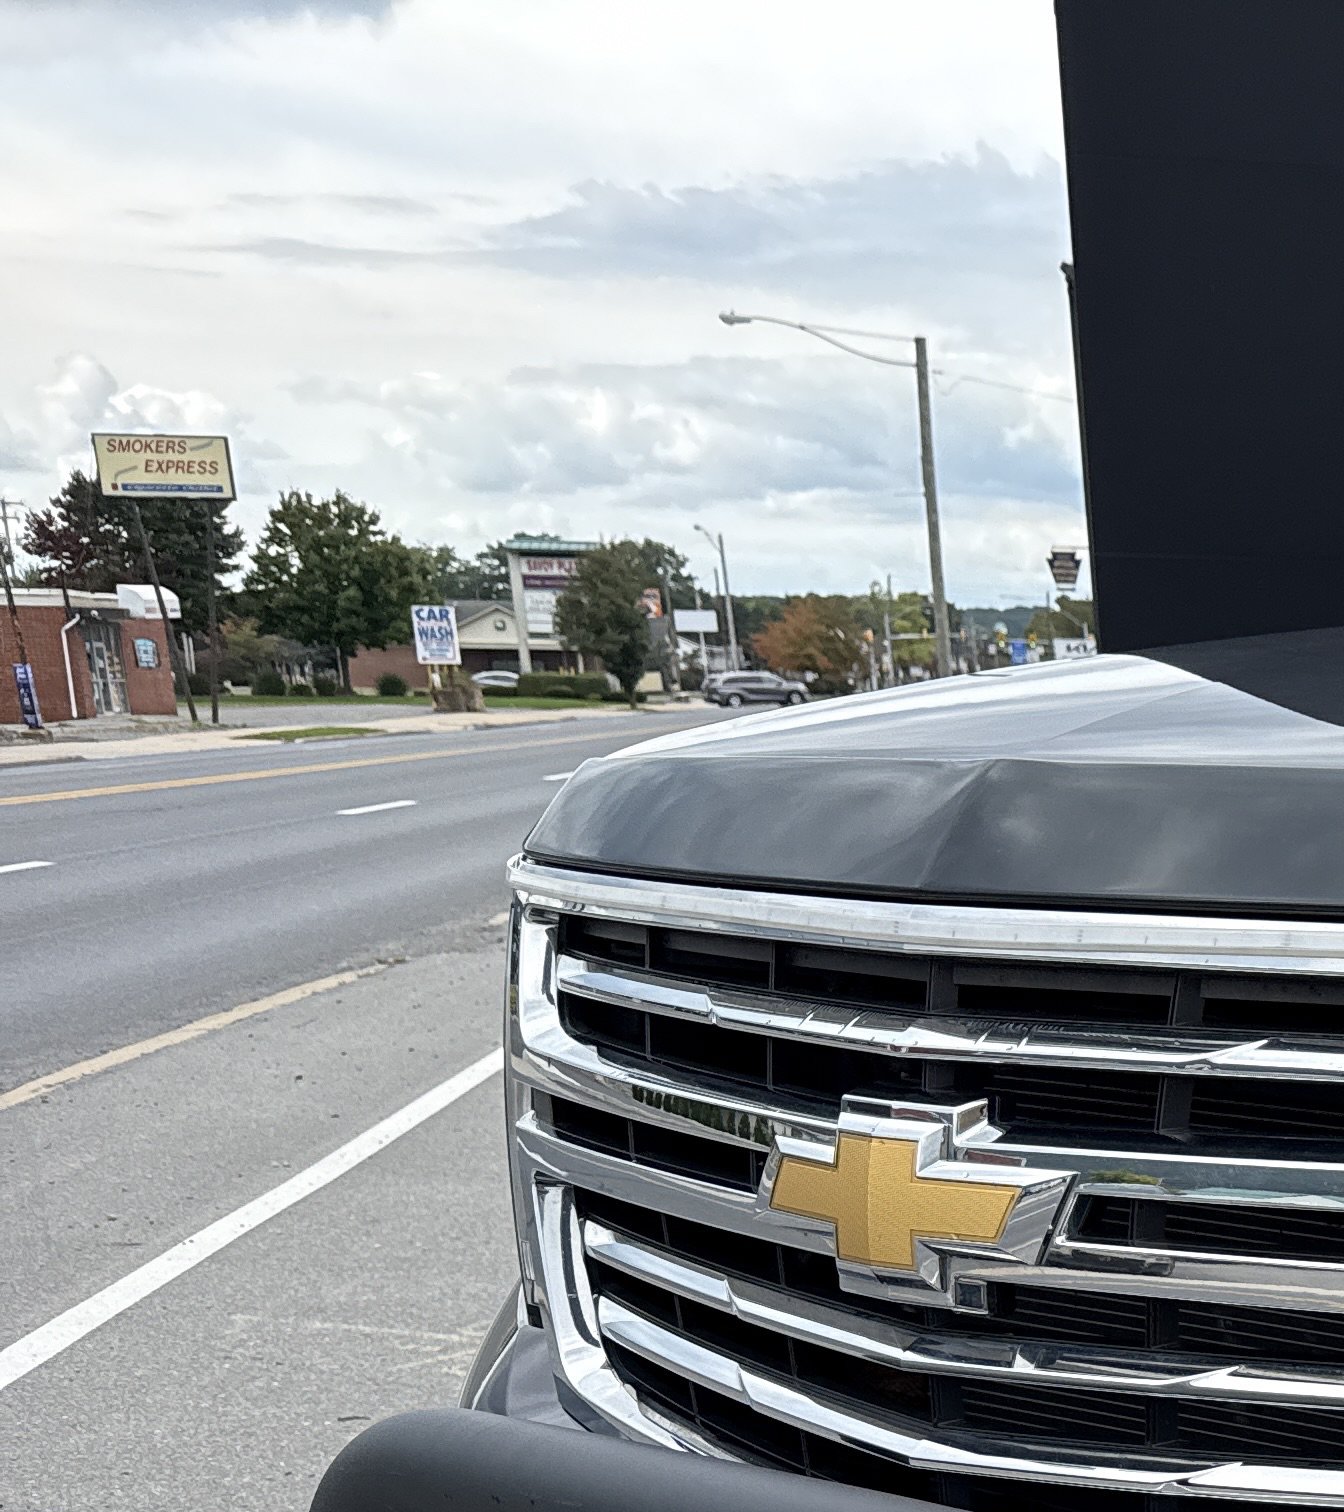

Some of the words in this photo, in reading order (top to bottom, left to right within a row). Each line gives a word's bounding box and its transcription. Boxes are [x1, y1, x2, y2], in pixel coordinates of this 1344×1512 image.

[106, 438, 187, 455] SMOKERS
[144, 459, 219, 475] EXPRESS
[415, 608, 451, 623] CAR
[417, 626, 454, 641] WASH
